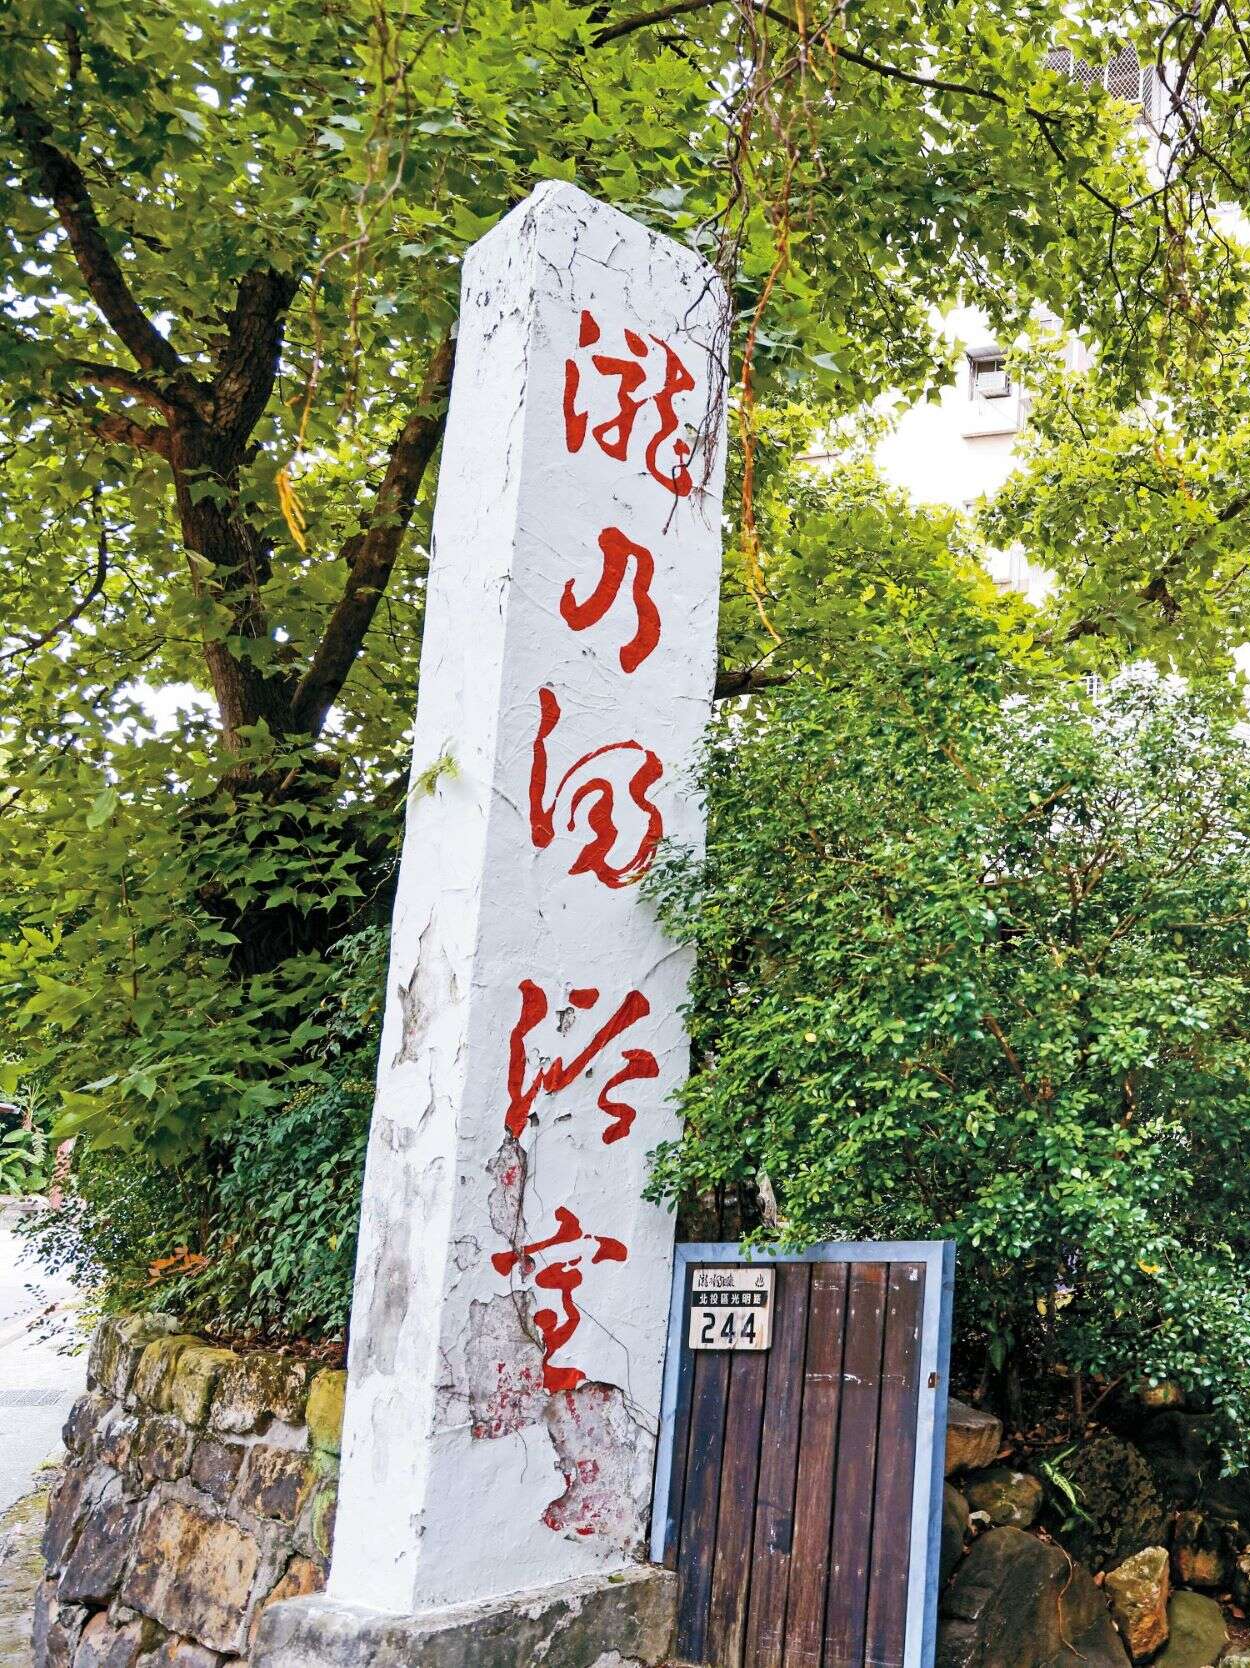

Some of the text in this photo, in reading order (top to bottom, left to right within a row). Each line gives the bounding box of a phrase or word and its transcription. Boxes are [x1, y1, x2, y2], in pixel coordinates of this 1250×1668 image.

[699, 1293, 762, 1305] 北投區光明路
[701, 1312, 756, 1344] 244
